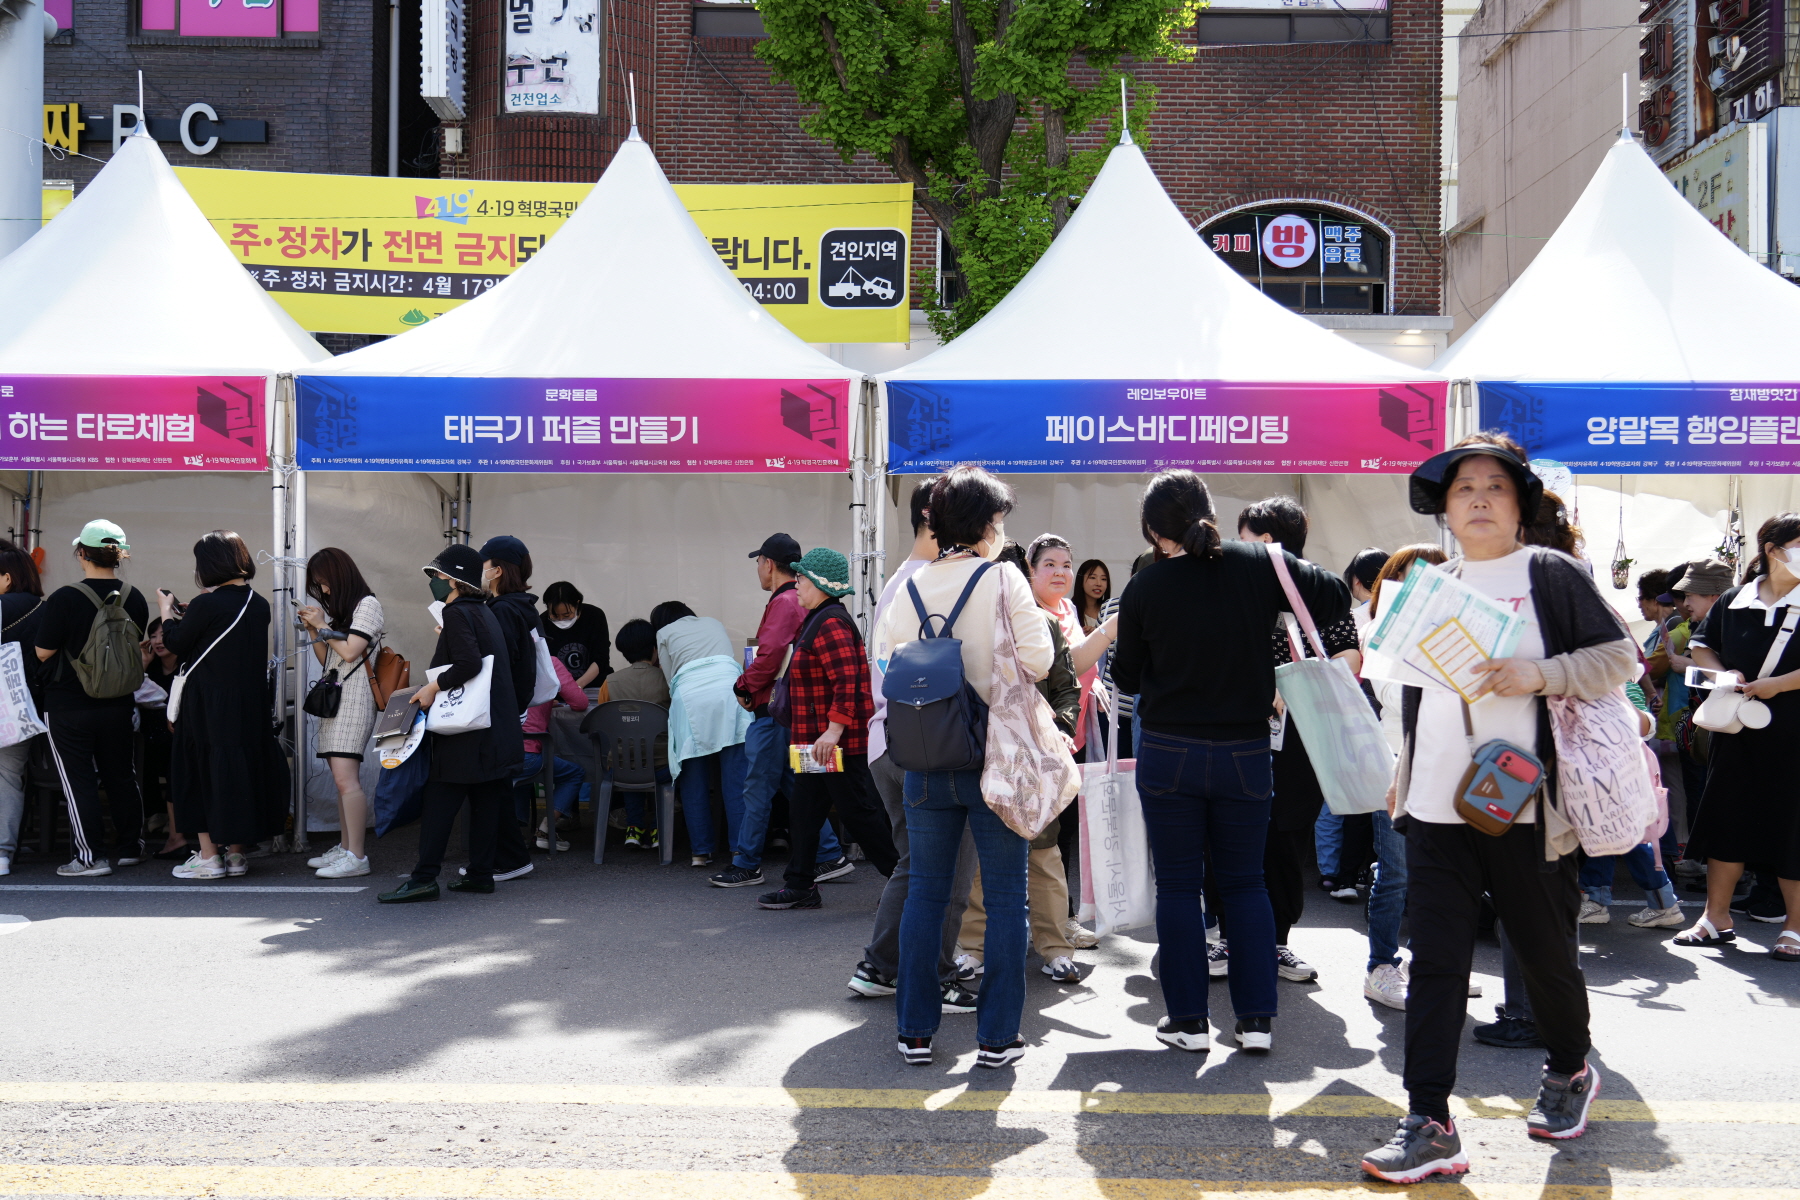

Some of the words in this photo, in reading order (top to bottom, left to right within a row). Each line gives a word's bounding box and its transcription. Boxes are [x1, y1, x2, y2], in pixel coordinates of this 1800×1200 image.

[510, 92, 562, 107] 건전업소
[1733, 79, 1775, 121] 지하
[229, 222, 373, 263] 주·정차가
[382, 229, 444, 265] 전면
[1212, 233, 1251, 253] 커피
[1271, 224, 1309, 259] 방
[1323, 225, 1362, 243] 맥주
[705, 236, 812, 271] 랍니다.
[829, 240, 898, 262] 견인지역
[1323, 246, 1362, 264] 음료
[262, 268, 328, 291] 주·정차
[333, 271, 414, 294] 금지시간:
[422, 275, 453, 296] 4월
[0, 385, 15, 398] 로
[545, 388, 598, 402] 문화돋음
[1126, 388, 1207, 401] 레인보우아트
[1728, 387, 1798, 402] 참새방앗간
[8, 411, 69, 442] 하는
[76, 413, 195, 443] 타로체험
[444, 415, 534, 444] 태극기
[541, 415, 601, 444] 퍼즐
[609, 416, 699, 445] 만들기
[1045, 415, 1289, 444] 페이스바디페인팅
[1586, 415, 1680, 445] 양말목
[567, 652, 581, 669] G
